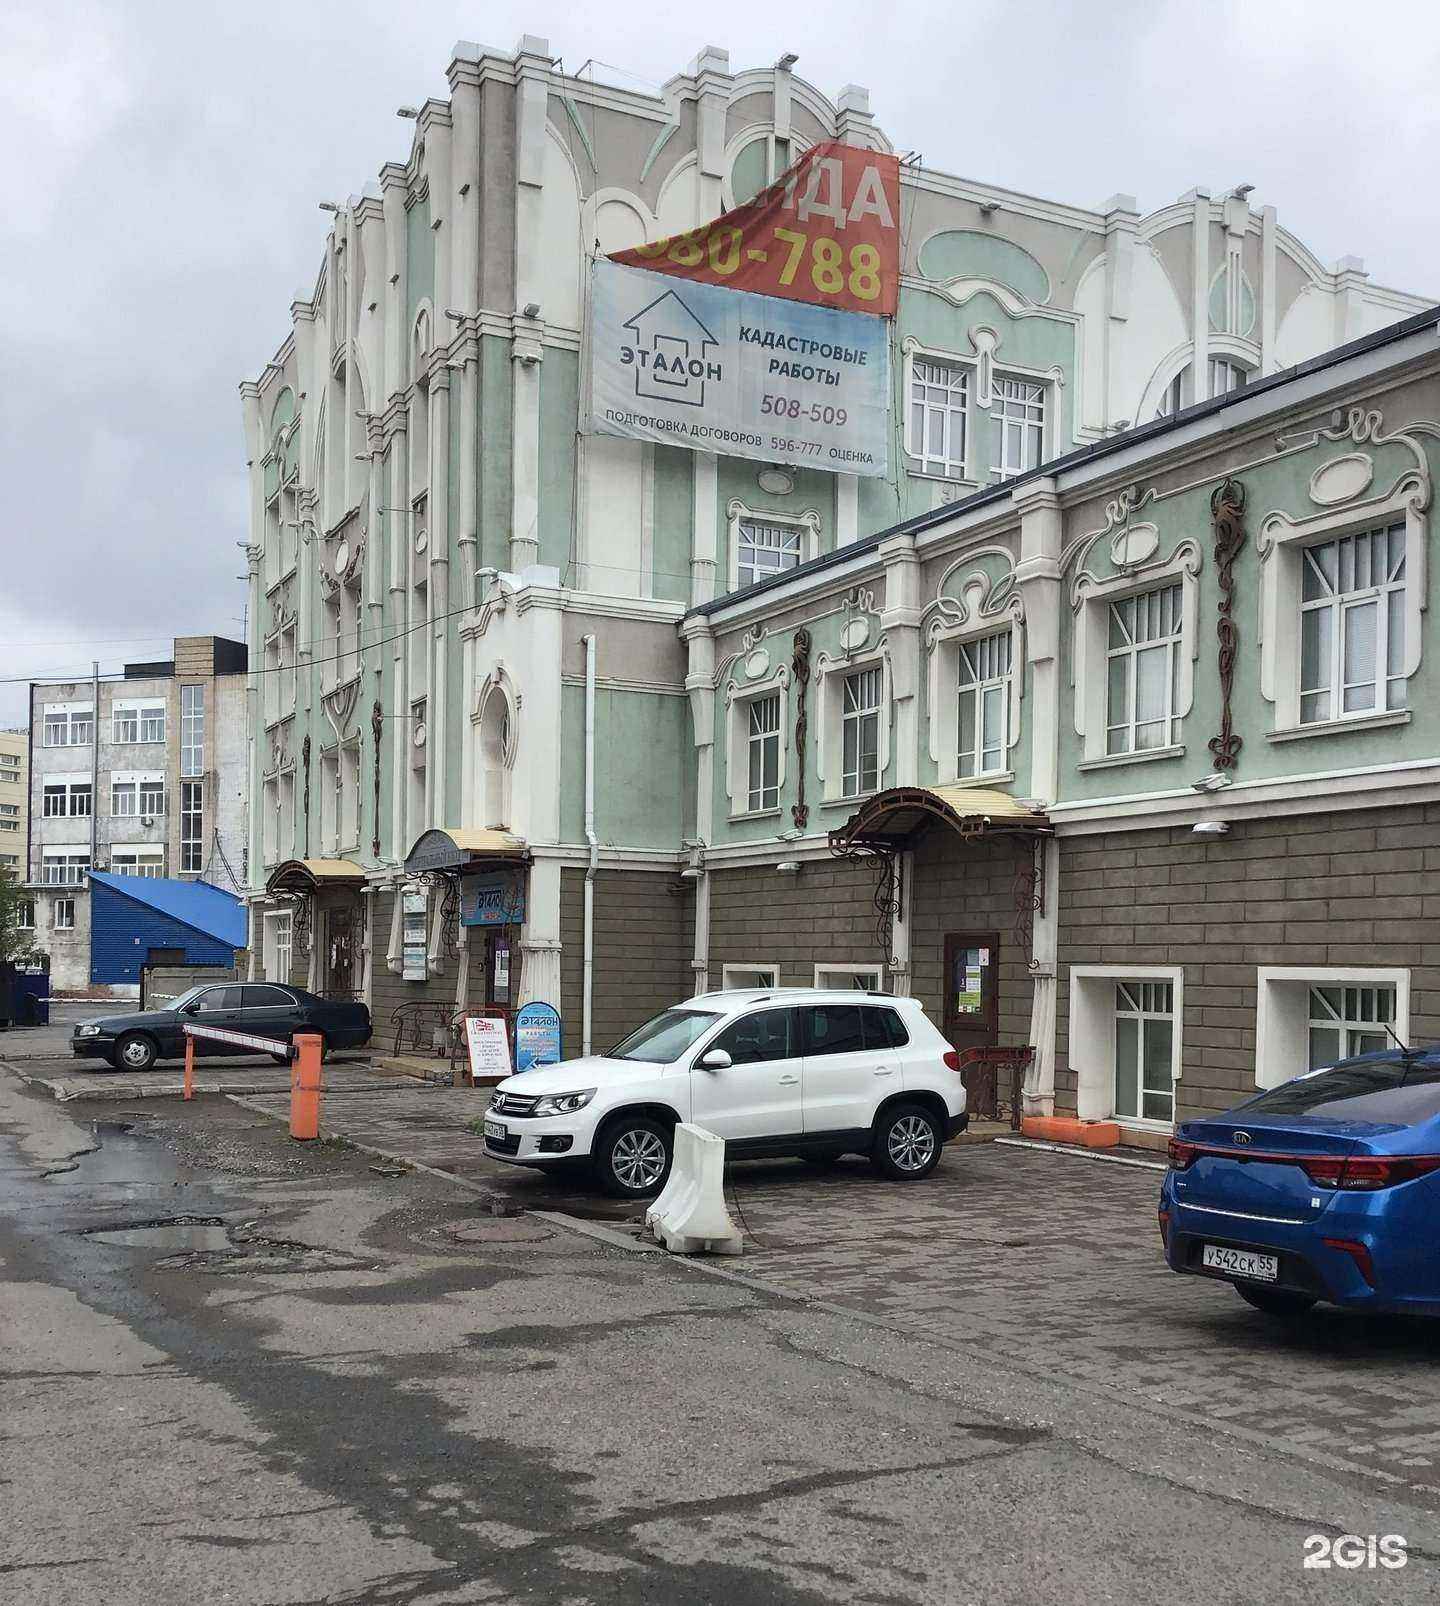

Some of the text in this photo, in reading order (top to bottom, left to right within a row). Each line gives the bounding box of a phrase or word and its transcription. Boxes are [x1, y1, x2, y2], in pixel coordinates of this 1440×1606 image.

[634, 224, 881, 300] 80-788
[738, 326, 868, 365] КАДАСТРОВЫЕ
[620, 346, 721, 381] ЭТАЛОН
[769, 358, 841, 386] РАБОТЫ
[760, 394, 848, 426] 508-509
[606, 409, 874, 465] ПОДГОТОВКА ДОГОВОРОВ 596-777 ОЦЕНКА
[1207, 1249, 1273, 1273] У542СК 55
